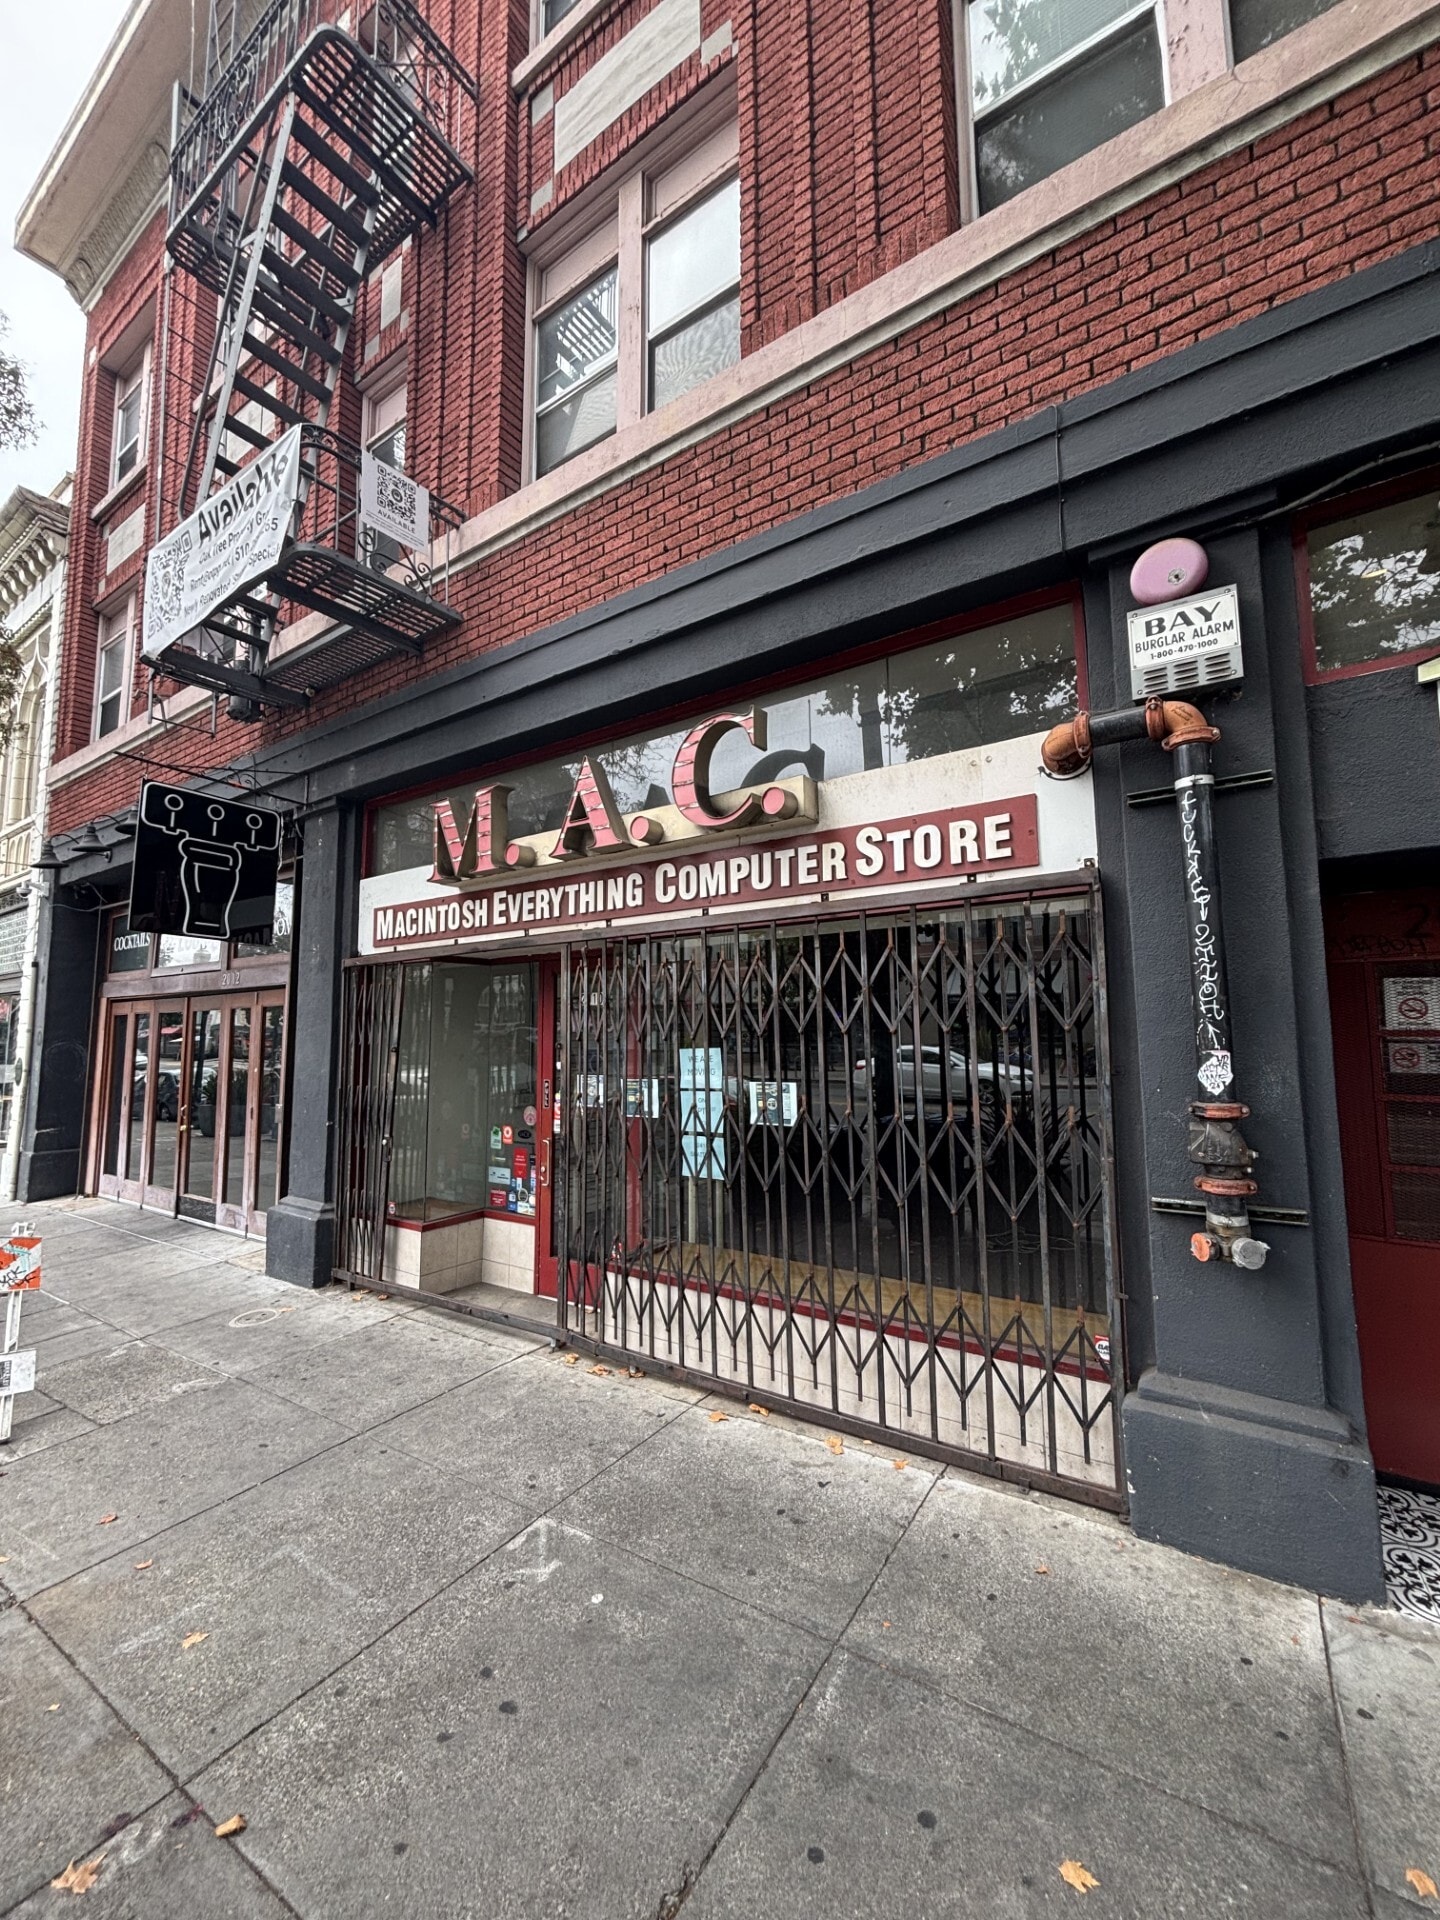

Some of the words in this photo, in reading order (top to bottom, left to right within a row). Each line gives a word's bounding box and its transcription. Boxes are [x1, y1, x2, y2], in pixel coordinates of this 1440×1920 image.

[378, 509, 416, 534] AVAILABLE
[1145, 601, 1220, 637] BAY
[1135, 631, 1186, 653] BURGLAR
[1192, 619, 1234, 639] ALARM
[1151, 638, 1218, 660] 1-800-470-1000
[376, 897, 488, 942] MACINTOSH
[493, 872, 644, 926] EVERYTHING
[655, 841, 848, 903] COMPUTER
[855, 813, 1013, 877] STORE
[113, 933, 151, 952] COCKTAILS
[221, 971, 240, 987] 2012
